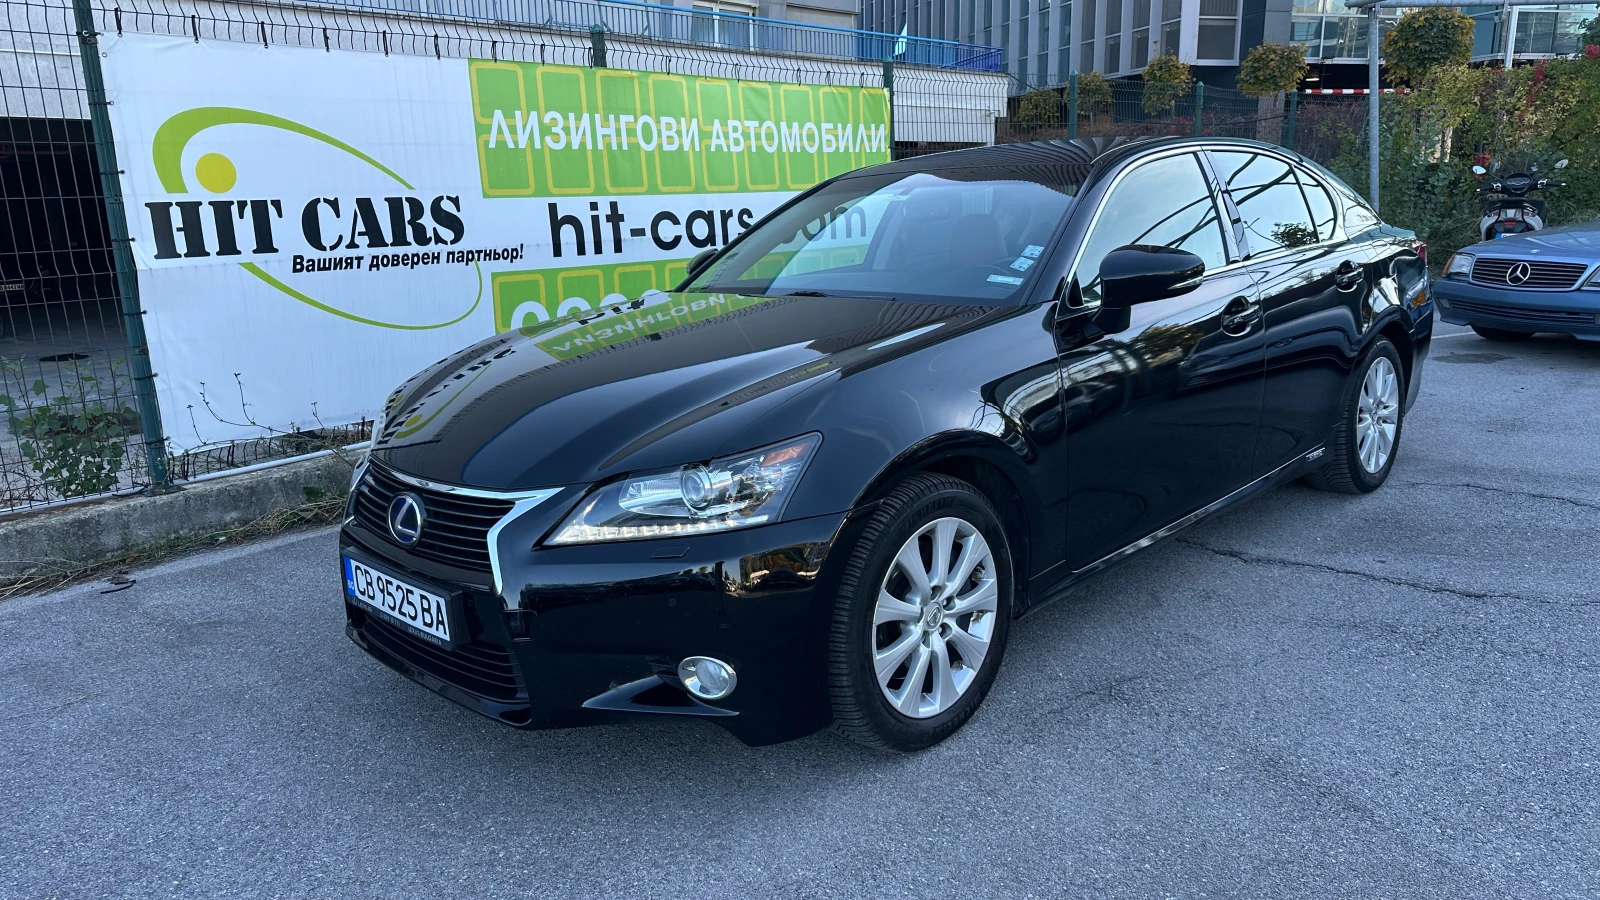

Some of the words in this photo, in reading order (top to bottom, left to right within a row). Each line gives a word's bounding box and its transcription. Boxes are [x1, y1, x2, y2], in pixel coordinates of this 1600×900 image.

[488, 109, 701, 152] ЛИЗИНГОВИ
[710, 118, 887, 153] АВТОМОБИЛИ
[144, 199, 283, 260] HIT
[301, 194, 465, 252] CARS
[292, 253, 364, 274] Вашият
[368, 251, 441, 272] доверен
[446, 243, 524, 266] партньор!
[355, 565, 375, 601] CB
[376, 575, 418, 622] 9525
[419, 593, 448, 636] BA
